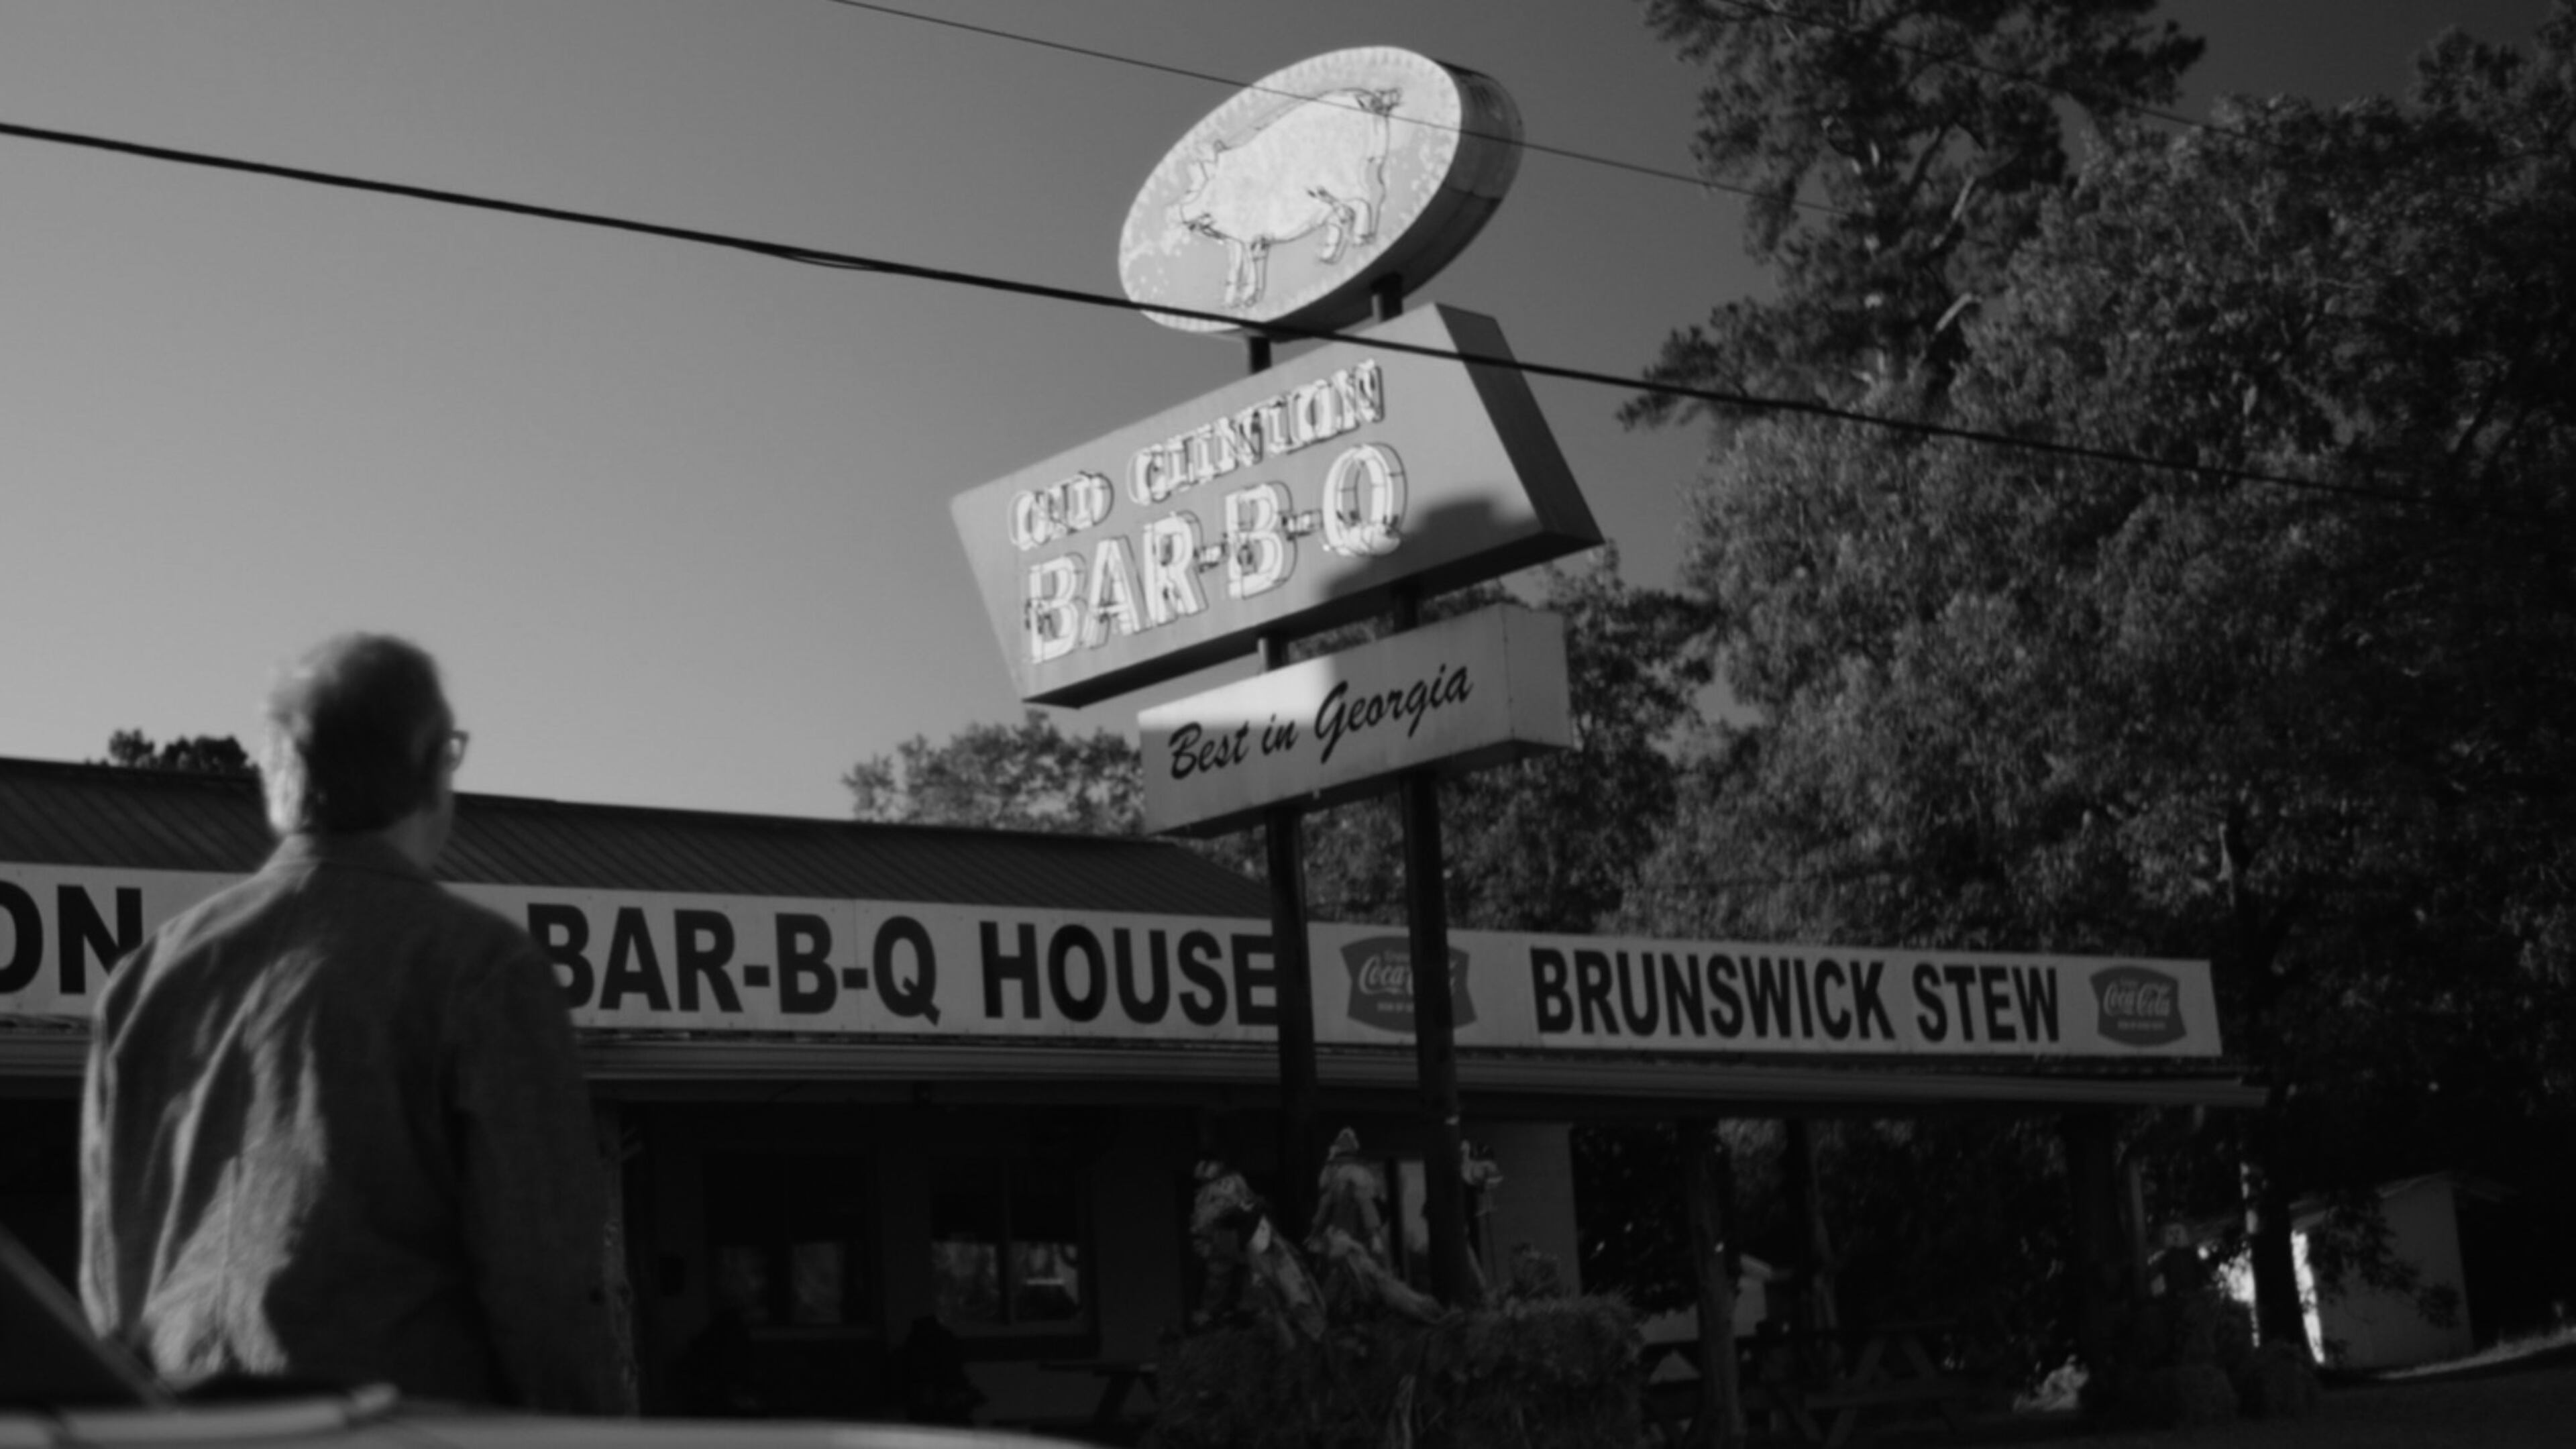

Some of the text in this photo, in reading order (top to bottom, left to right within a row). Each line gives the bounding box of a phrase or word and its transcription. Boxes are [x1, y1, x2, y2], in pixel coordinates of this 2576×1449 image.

[1024, 442, 1408, 663] BAR-B-Q
[1169, 663, 1473, 779] Best in Georgia
[527, 903, 940, 1026] BAR-B-Q
[979, 921, 1279, 1026] HOUSE
[1531, 948, 2060, 1042] BRUNSWICK STEW
